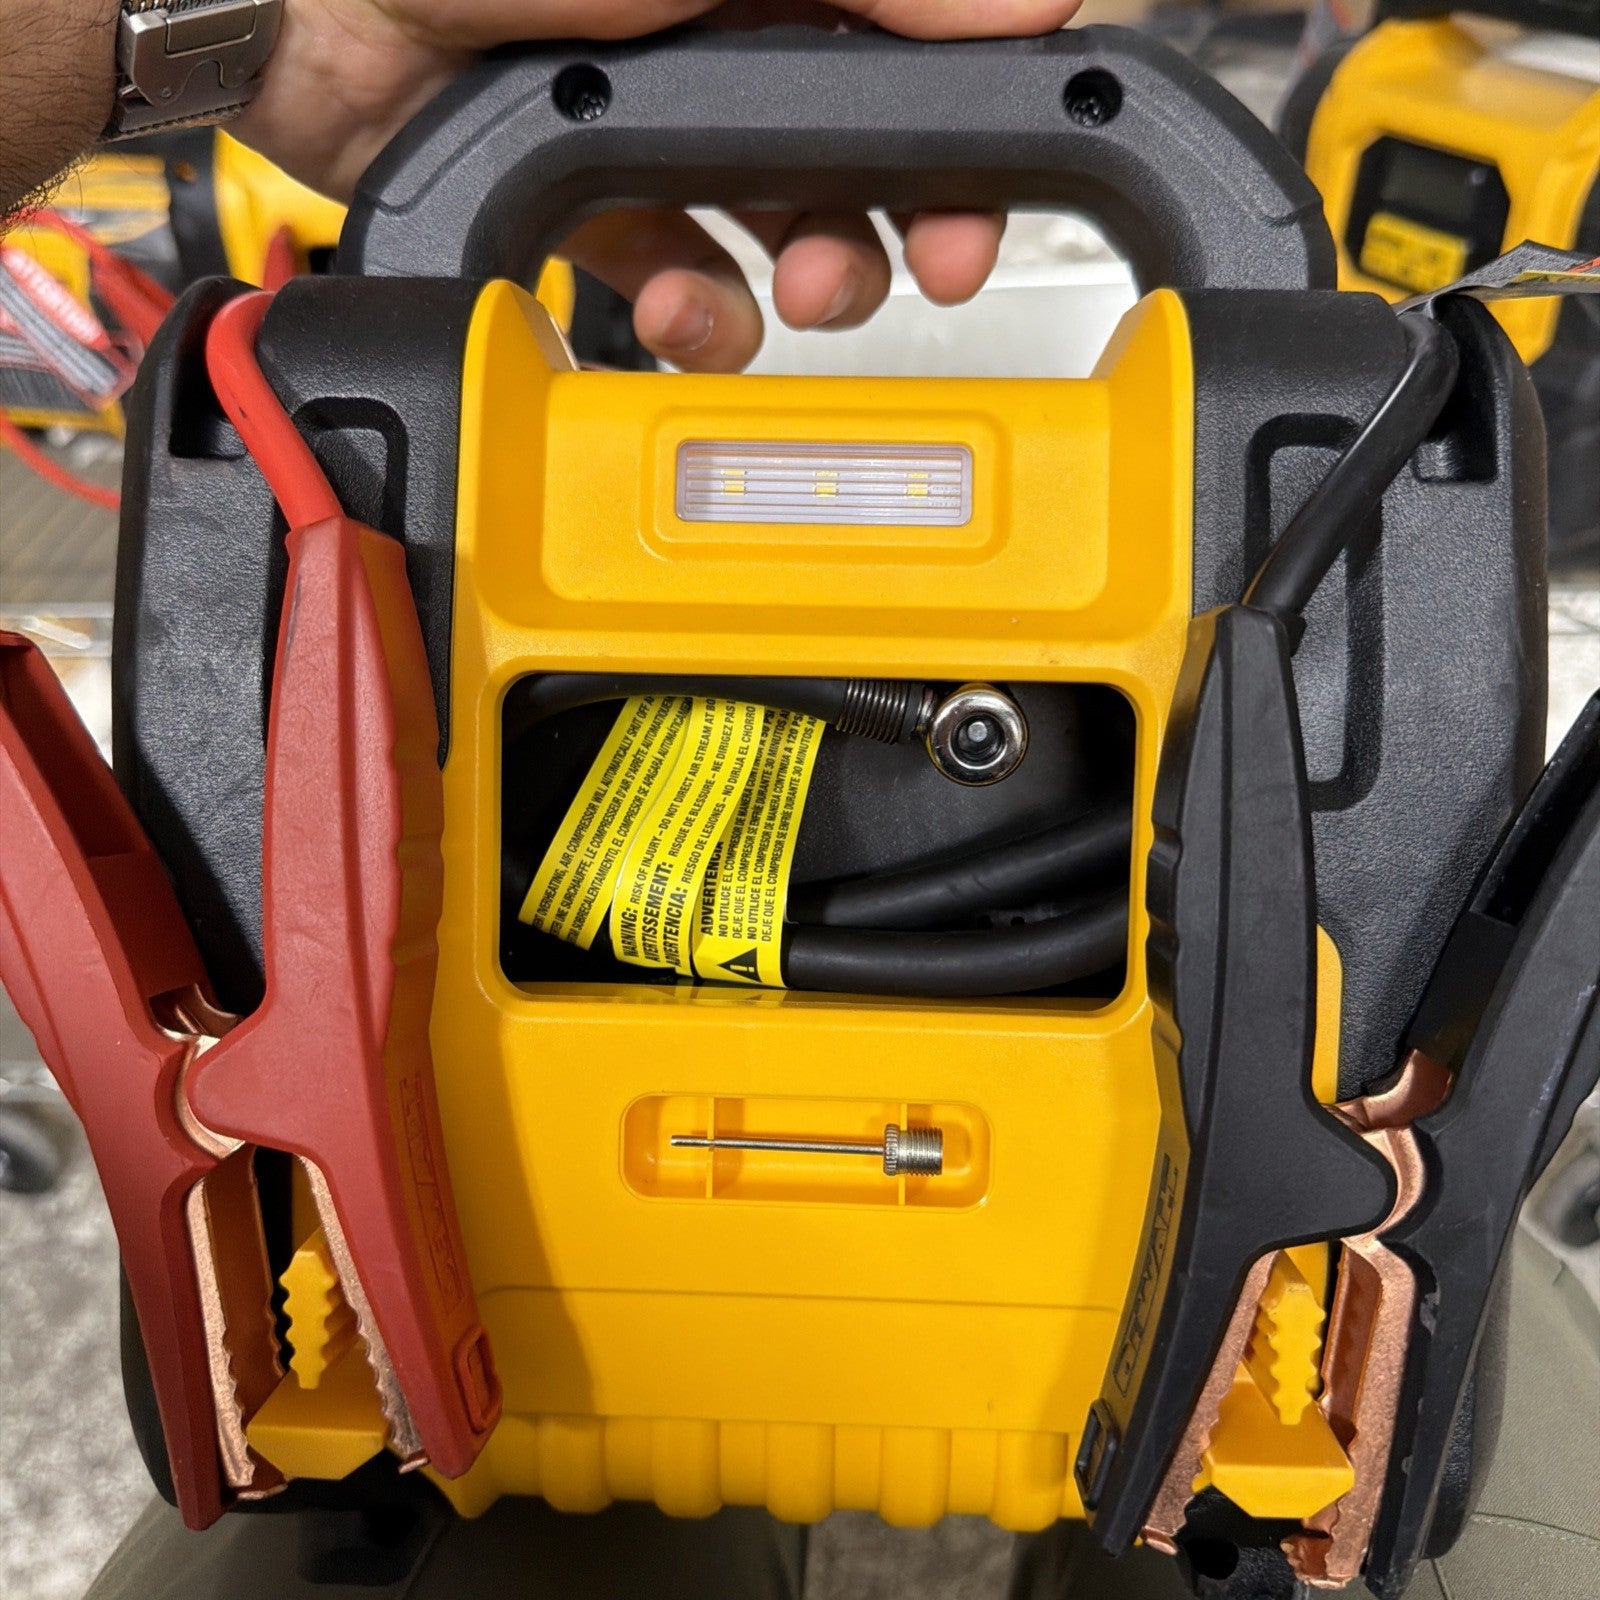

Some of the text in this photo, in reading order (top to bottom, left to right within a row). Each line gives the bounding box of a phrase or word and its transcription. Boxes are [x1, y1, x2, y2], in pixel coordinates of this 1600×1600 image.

[636, 702, 650, 719] OFF
[704, 712, 715, 725] AT
[724, 705, 736, 724] PAS
[626, 717, 643, 737] SHUT
[741, 706, 756, 743] CHORRO
[694, 726, 712, 762] STREAM
[715, 725, 733, 760] DIRIGEZ
[767, 719, 787, 757] MINUTOS
[786, 728, 799, 744] 120
[795, 727, 814, 765] MINUTOS
[601, 735, 633, 787] AUTOMATICALLY
[738, 745, 750, 756] EL
[783, 746, 793, 754] A
[688, 762, 701, 777] AIR
[711, 760, 723, 772] NE
[727, 757, 746, 784] DIRIJA
[764, 758, 775, 770] 30
[773, 754, 791, 794] CONTINUA
[792, 765, 803, 777] 30
[591, 787, 608, 804] WILL
[615, 778, 632, 799] D'AIR
[637, 785, 650, 797] SE
[673, 777, 694, 803] DIRECT
[688, 779, 715, 817] BLESSURE
[721, 784, 735, 796] NO
[755, 769, 772, 805] DURANTE
[784, 777, 800, 810] DURANTE
[664, 803, 680, 818] NOT
[737, 787, 753, 817] MANERA
[766, 794, 781, 822] MANERA
[590, 797, 622, 848] COMPRESSEUR
[617, 795, 644, 837] COMPRESOR
[658, 818, 672, 830] DO
[682, 816, 696, 828] DE
[700, 803, 726, 839] LESIONES
[734, 817, 746, 826] DE
[763, 822, 775, 831] DE
[566, 803, 599, 853] COMPRESSOR
[747, 826, 758, 835] SE
[776, 831, 788, 840] SE
[611, 837, 625, 848] EL
[641, 836, 662, 868] INJURY
[668, 827, 690, 857] RISQUE
[694, 838, 708, 851] DE
[724, 826, 743, 871] COMPRESOR
[754, 831, 772, 873] COMPRESOR
[559, 852, 574, 868] AIR
[584, 847, 598, 860] LE
[737, 835, 755, 882] COMPRESOR
[767, 840, 785, 885] COMPRESOR
[636, 867, 648, 881] OF
[681, 851, 701, 884] RIESGO
[722, 872, 733, 883] EL
[560, 860, 593, 909] SURCHAUFFE,
[735, 884, 747, 895] EL
[751, 875, 763, 885] EL
[537, 869, 567, 916] OVERHEATING,
[630, 881, 644, 905] RISK
[765, 886, 776, 897] EL
[642, 862, 673, 962] AVERTISSEMENT:
[719, 886, 731, 922] UTILICE
[733, 896, 745, 915] QUE
[748, 888, 761, 924] UTILICE
[763, 899, 775, 917] QUE
[621, 908, 639, 957] WARNING:
[664, 887, 687, 966] ADVERTENCIA:
[718, 924, 728, 937] NO
[732, 916, 743, 939] DEJE
[747, 926, 757, 940] NO
[761, 919, 773, 942] DEJE
